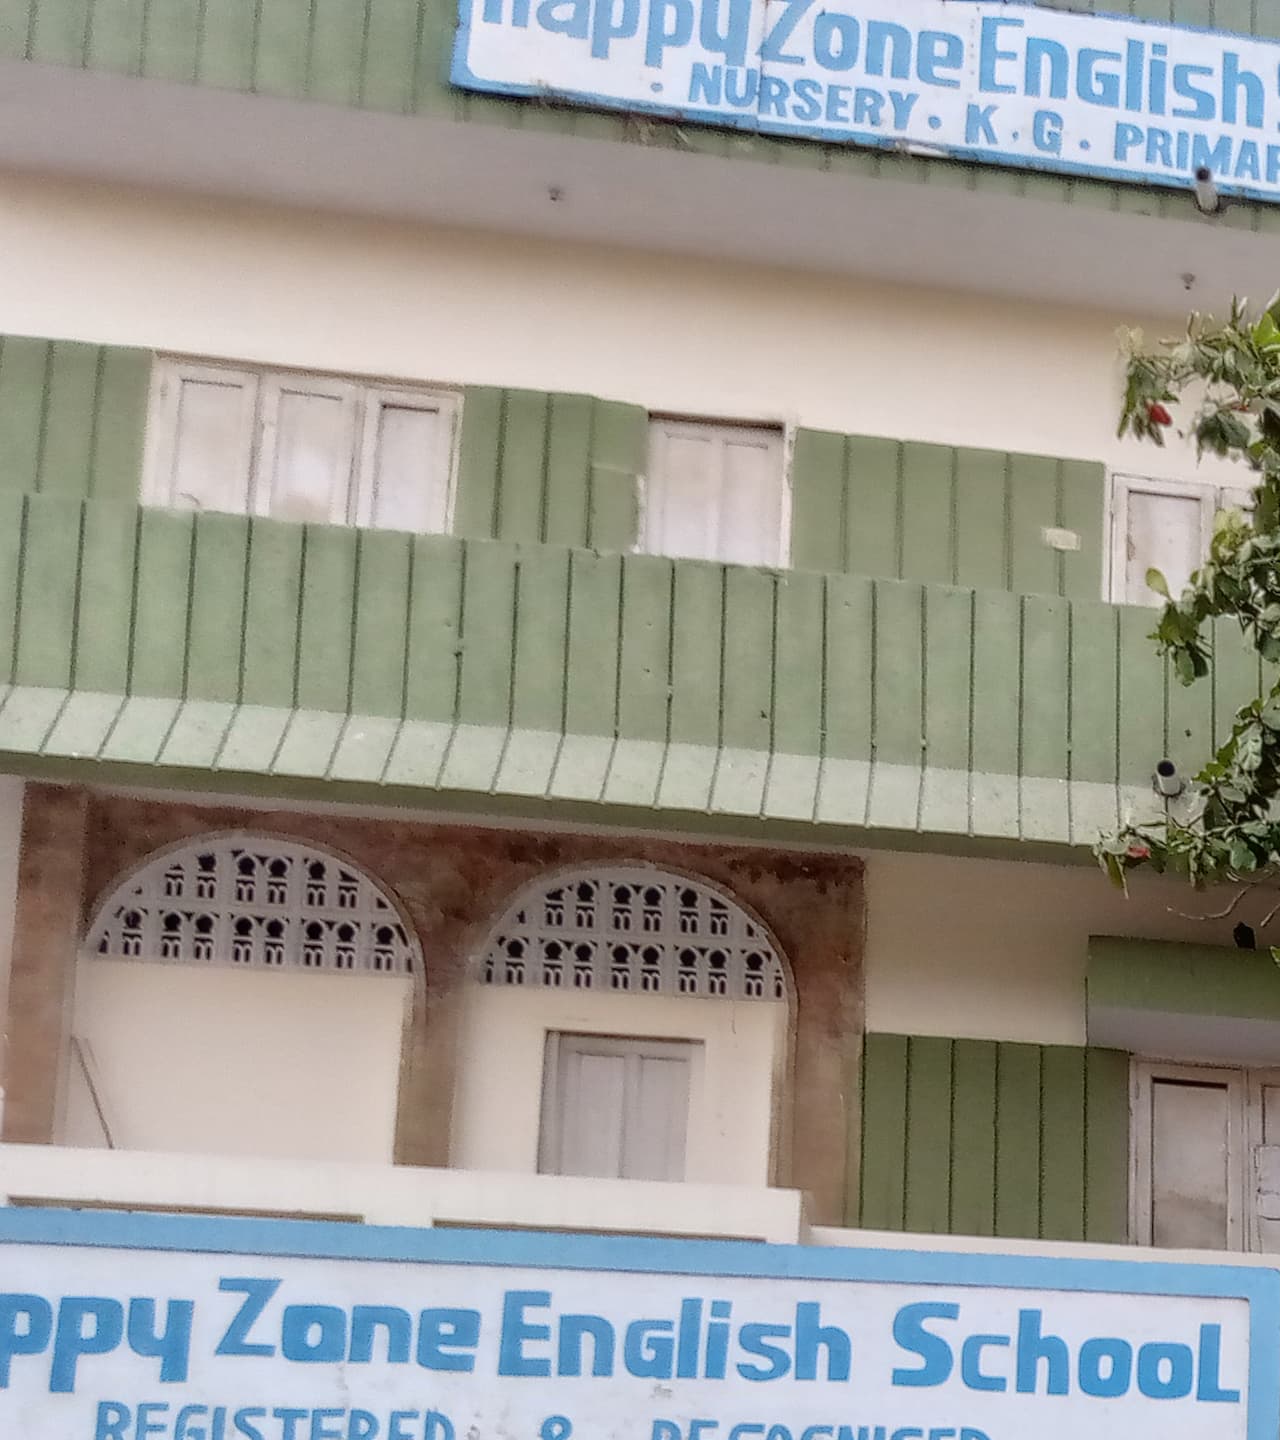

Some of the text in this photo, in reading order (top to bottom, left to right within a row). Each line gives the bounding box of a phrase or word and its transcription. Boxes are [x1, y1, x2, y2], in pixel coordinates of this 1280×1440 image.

[757, 0, 964, 88] Zone
[689, 64, 917, 128] NURSERY
[215, 1277, 480, 1372] Zone
